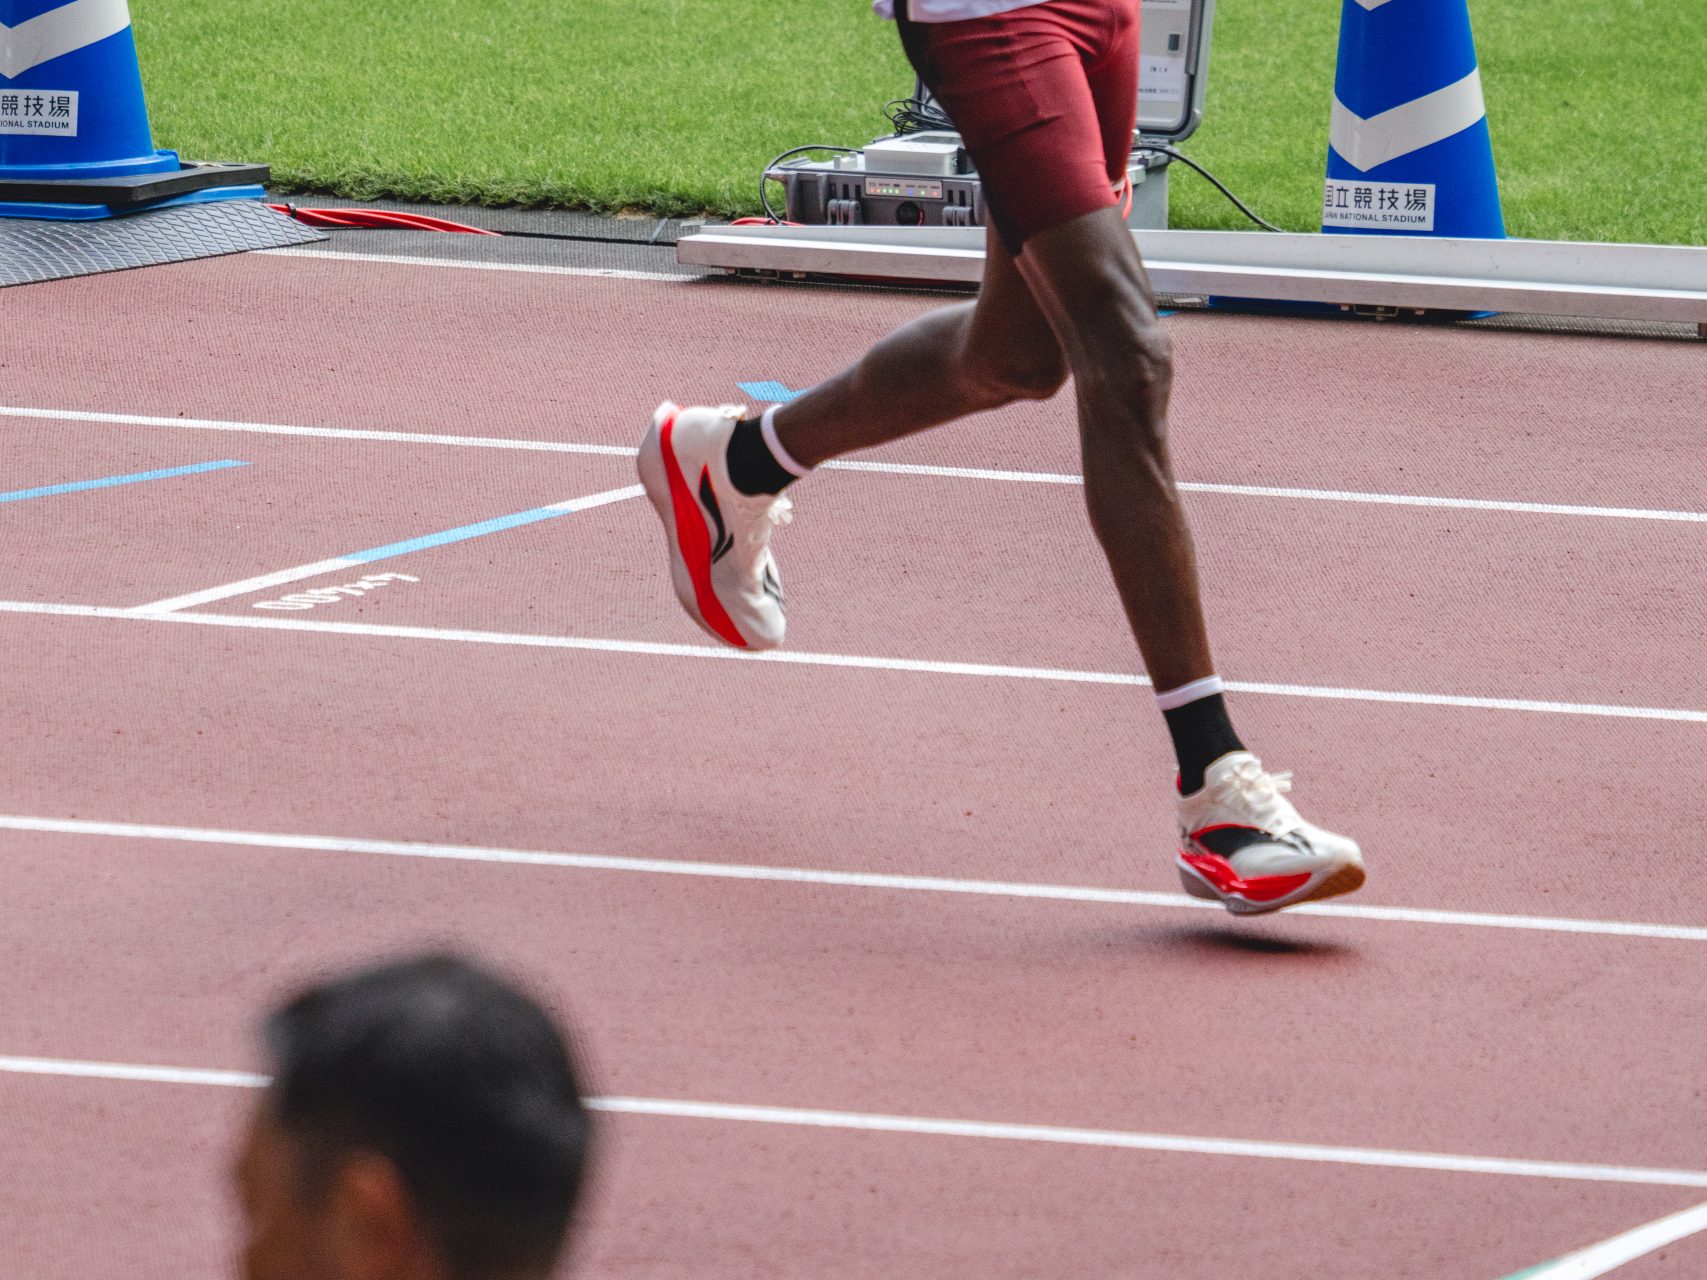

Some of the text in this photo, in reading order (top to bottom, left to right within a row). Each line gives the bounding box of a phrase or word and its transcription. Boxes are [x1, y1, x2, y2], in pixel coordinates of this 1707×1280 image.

[1, 95, 70, 117] 競技場
[27, 120, 69, 129] STADIUM
[1340, 213, 1379, 222] NATIONAL
[1382, 215, 1426, 223] STADIUM
